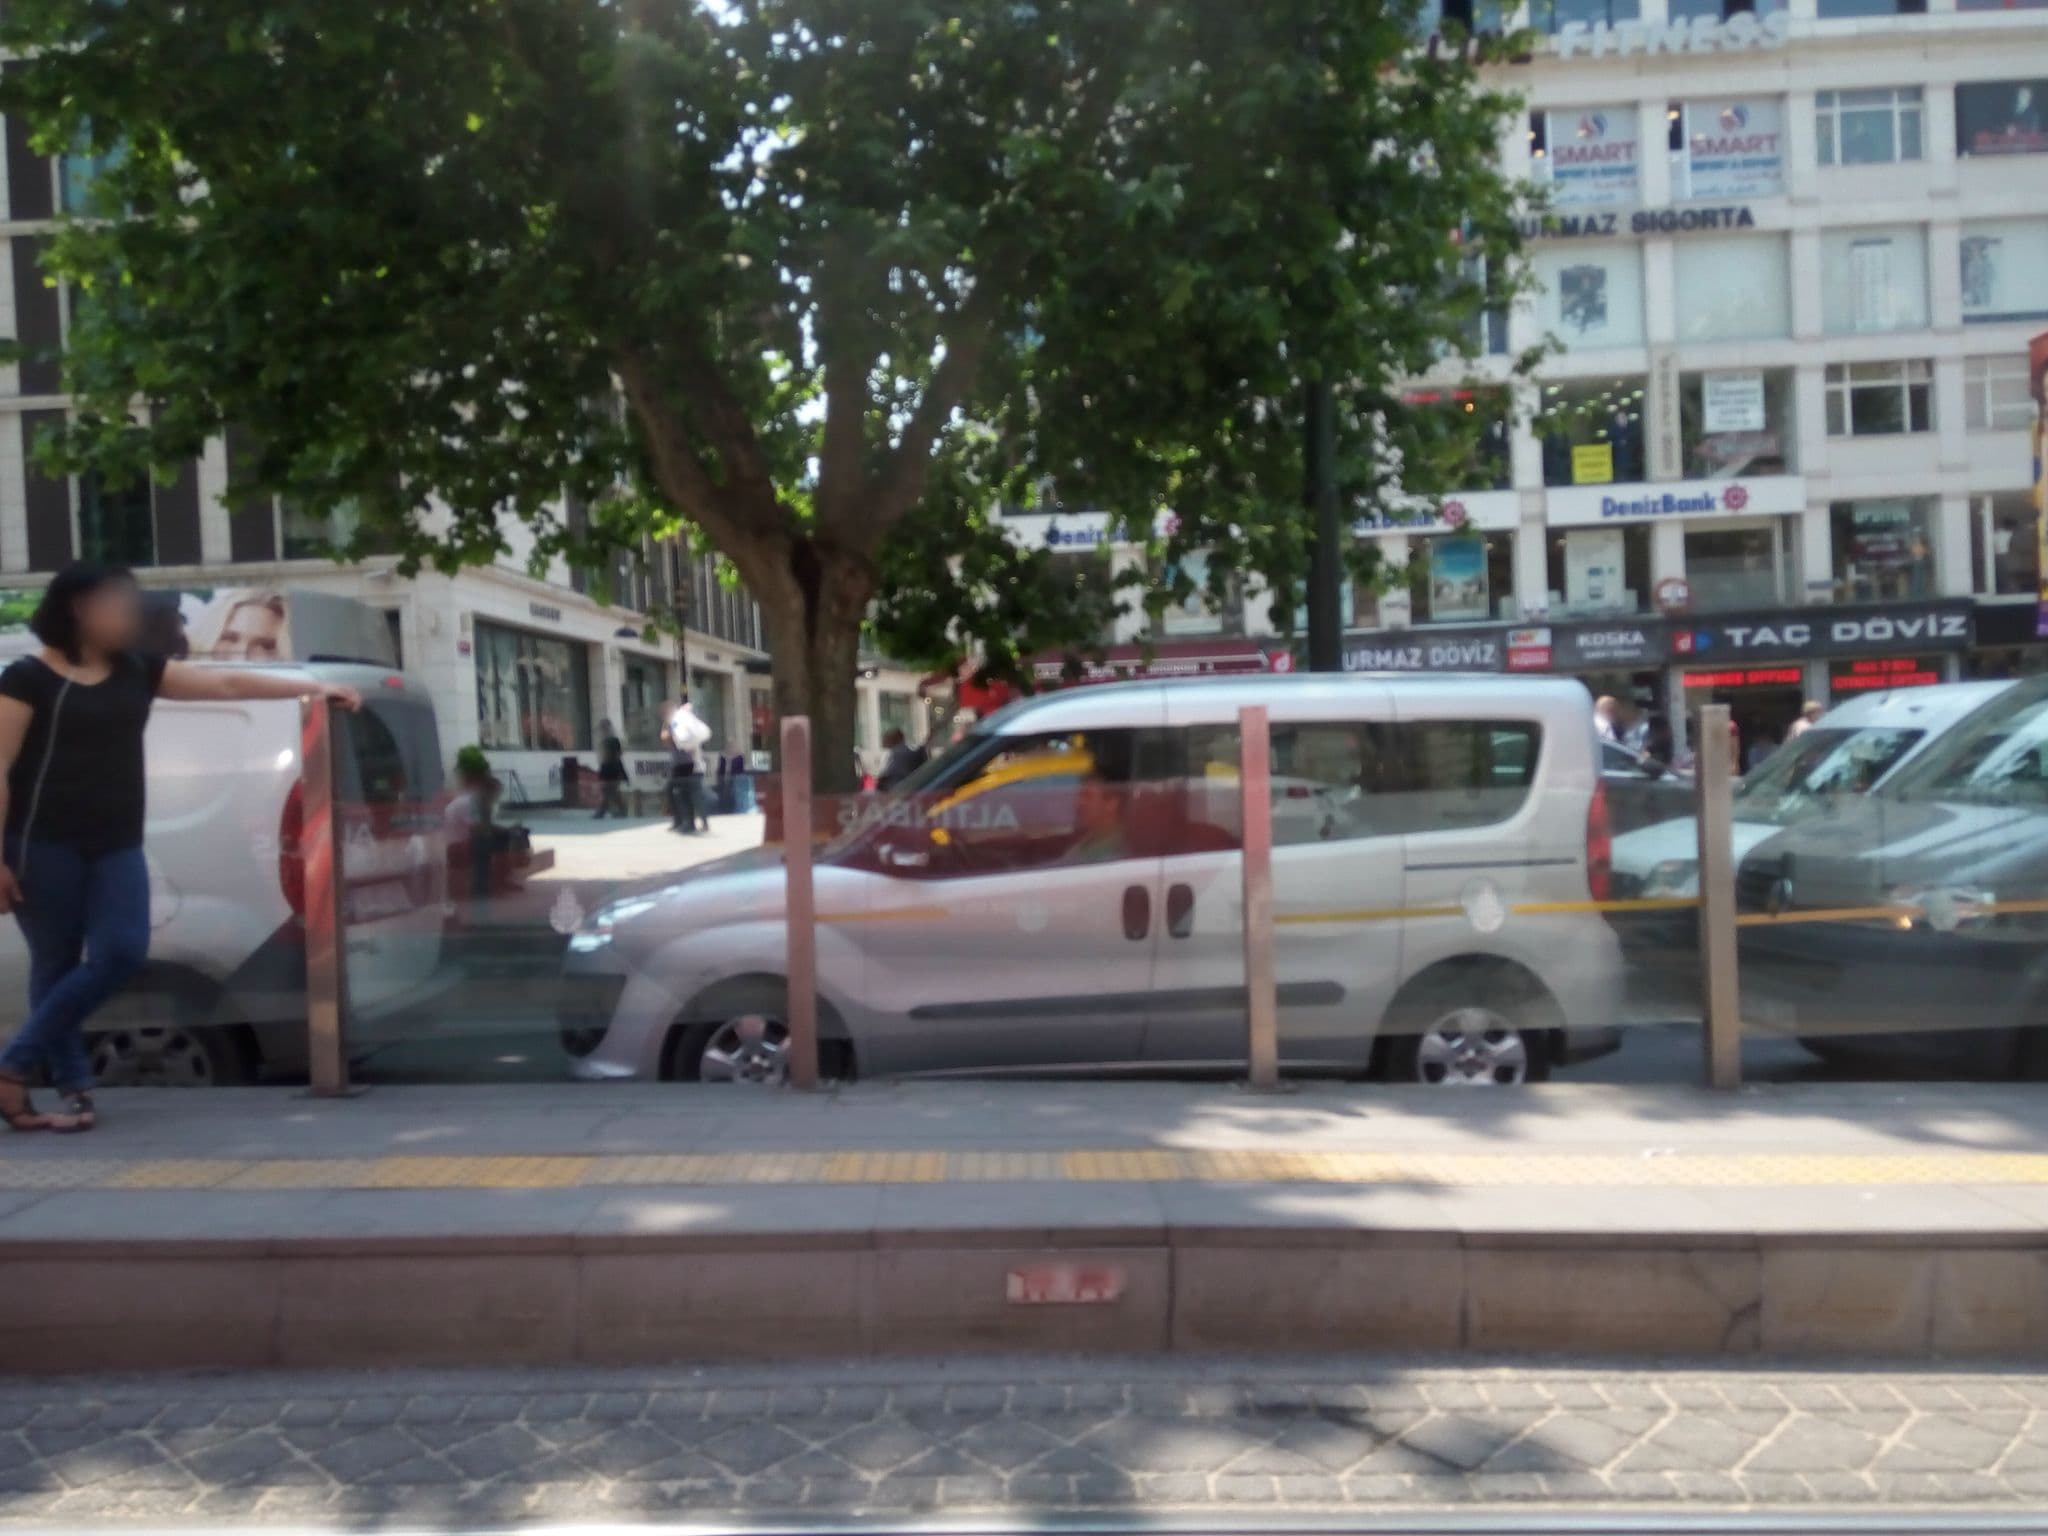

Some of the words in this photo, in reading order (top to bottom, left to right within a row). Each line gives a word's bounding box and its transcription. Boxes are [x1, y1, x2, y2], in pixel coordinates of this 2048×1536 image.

[1559, 10, 1790, 60] FITNESS
[1553, 142, 1636, 164] SMART
[1690, 133, 1779, 156] SMART
[1602, 491, 1717, 517] DenizBank
[1576, 629, 1646, 649] KOSKA
[1831, 612, 1968, 643] DÖVİZ
[1342, 647, 1424, 672] URMAZ
